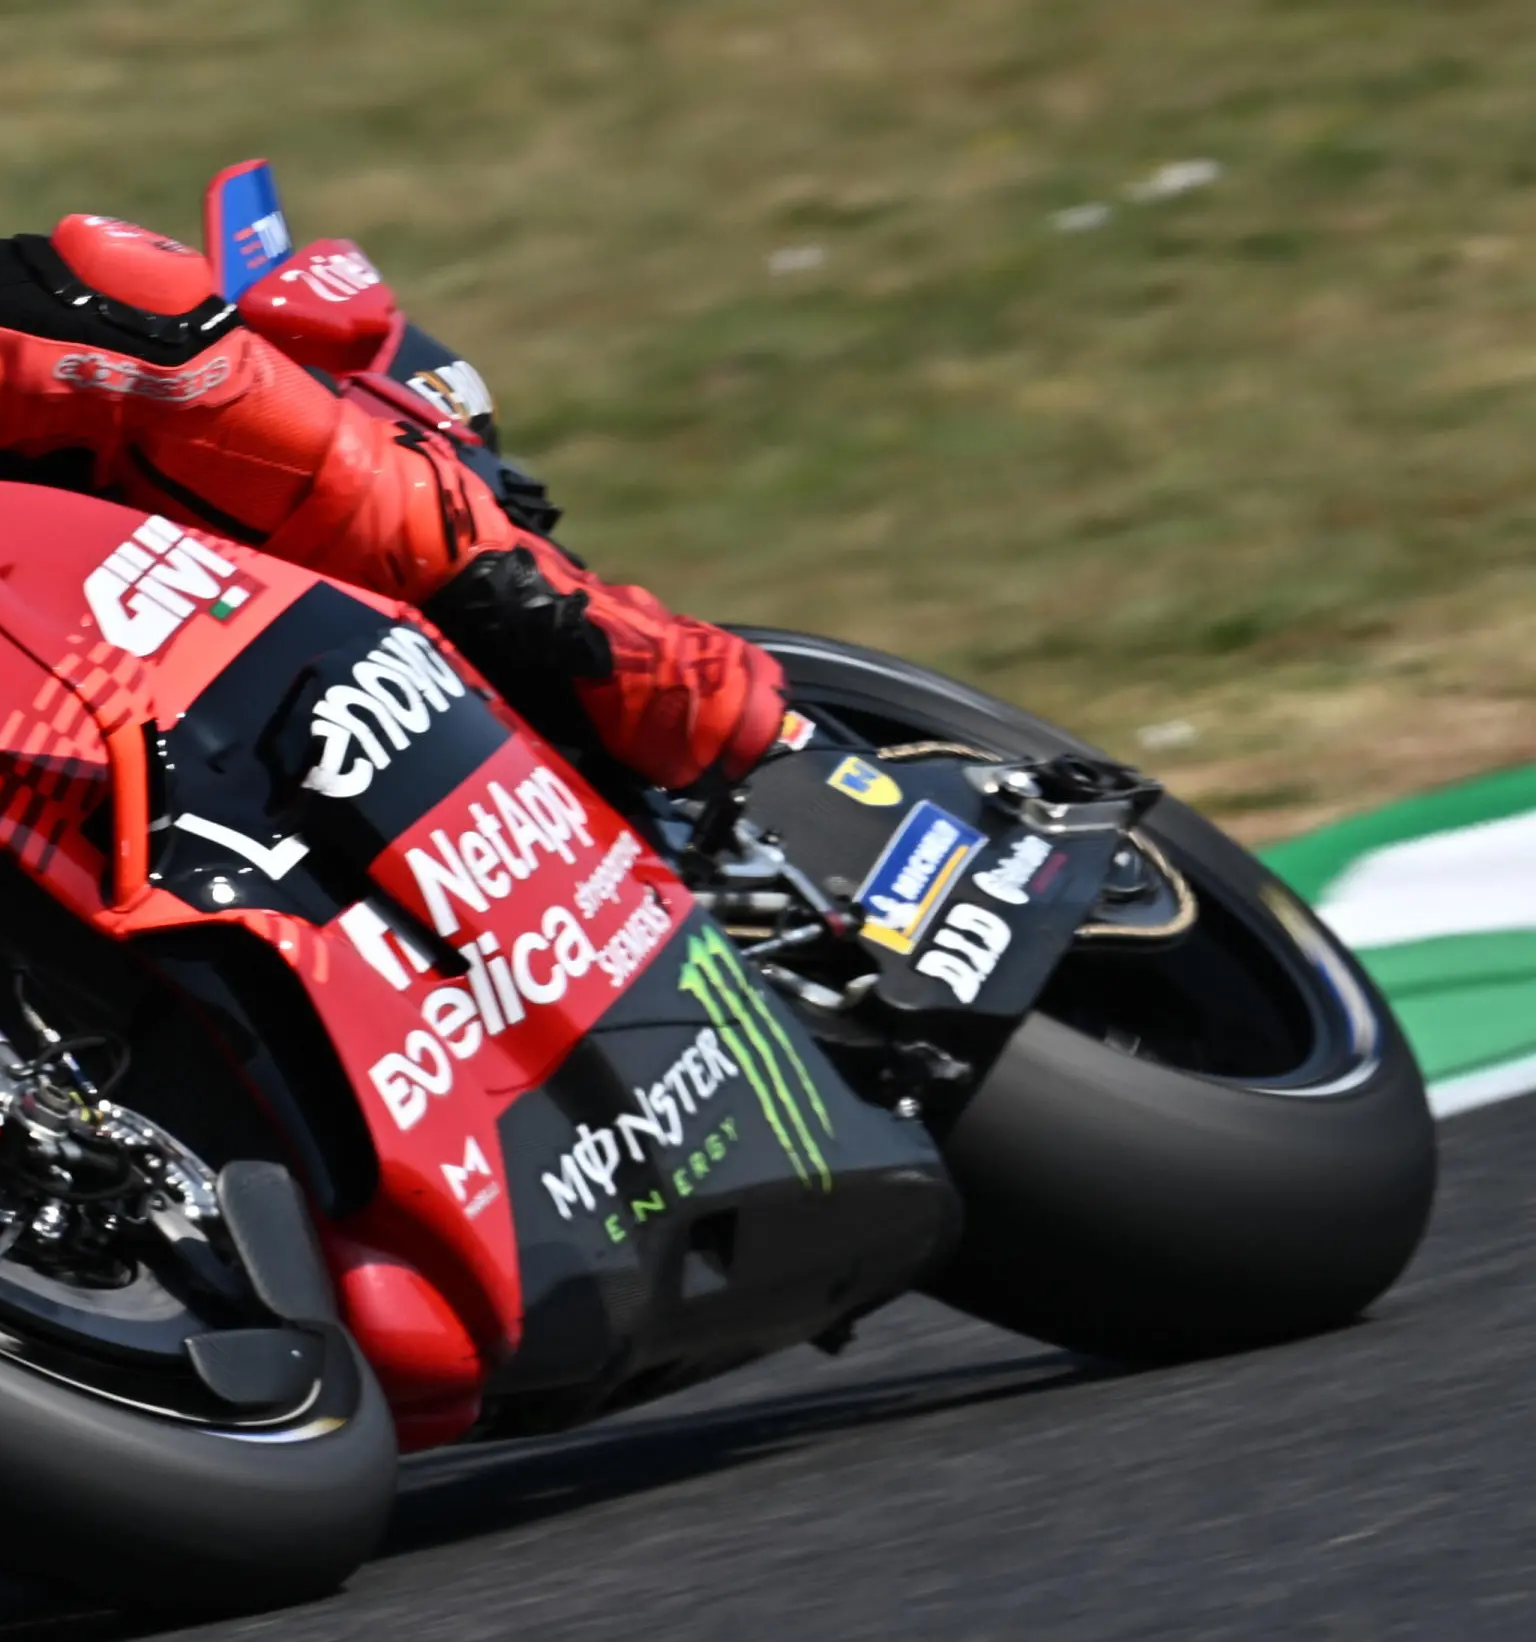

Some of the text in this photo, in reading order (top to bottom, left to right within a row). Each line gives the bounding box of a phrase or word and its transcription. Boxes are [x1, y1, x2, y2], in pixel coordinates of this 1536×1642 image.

[83, 513, 238, 658] GIVI
[403, 764, 595, 940] NetApp
[540, 1026, 739, 1221] MONSTER
[604, 1115, 739, 1244] ENERGY
